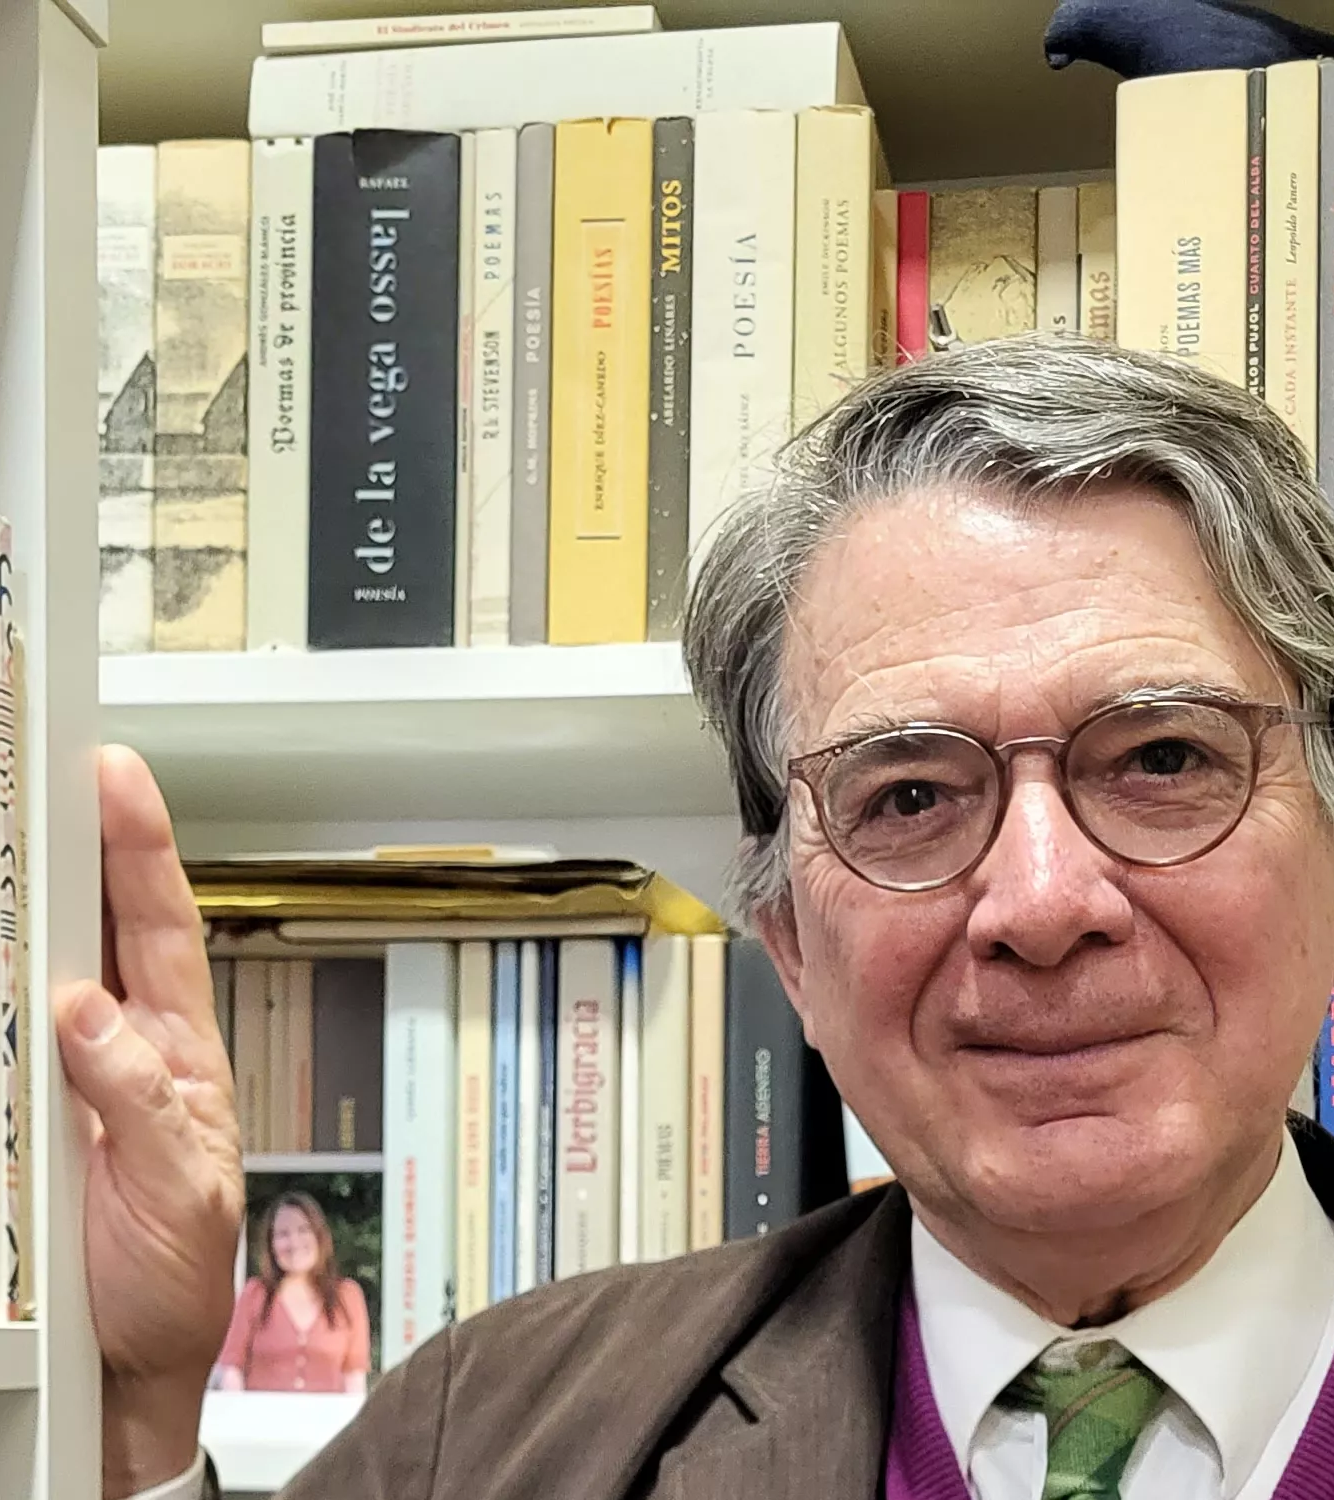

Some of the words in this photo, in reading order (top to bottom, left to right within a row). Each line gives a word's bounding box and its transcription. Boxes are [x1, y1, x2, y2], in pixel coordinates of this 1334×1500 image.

[1250, 155, 1262, 196] ALBA
[1284, 171, 1300, 212] Panero
[483, 191, 502, 281] POEMAS
[660, 179, 683, 274] MITOS
[833, 198, 851, 274] POEMAS
[1250, 199, 1262, 229] DEL
[1284, 214, 1301, 265] Leopoldo
[273, 213, 300, 313] provincia
[588, 247, 614, 329] POESÍAS
[1171, 235, 1202, 275] MÁS
[1250, 234, 1262, 295] CUARTO
[663, 293, 677, 352] LINARES
[728, 232, 758, 359] POESÍA
[833, 279, 849, 371] ALGUNOS
[1176, 281, 1202, 358] POEMAS
[1249, 303, 1261, 353] PUJOL
[1284, 278, 1298, 362] INSTANTE
[273, 322, 295, 348] de
[367, 342, 409, 444] vega
[481, 329, 501, 413] STEVENSON
[593, 350, 608, 446] DÍEZ-CANEDO
[663, 355, 677, 427] ABELARDO
[1285, 369, 1298, 417] CADA
[353, 460, 397, 502] la
[593, 450, 607, 512] ENRIQUE
[353, 517, 396, 574] de
[564, 1000, 604, 1174] Verbigracia
[754, 1126, 772, 1177] TIERRA
